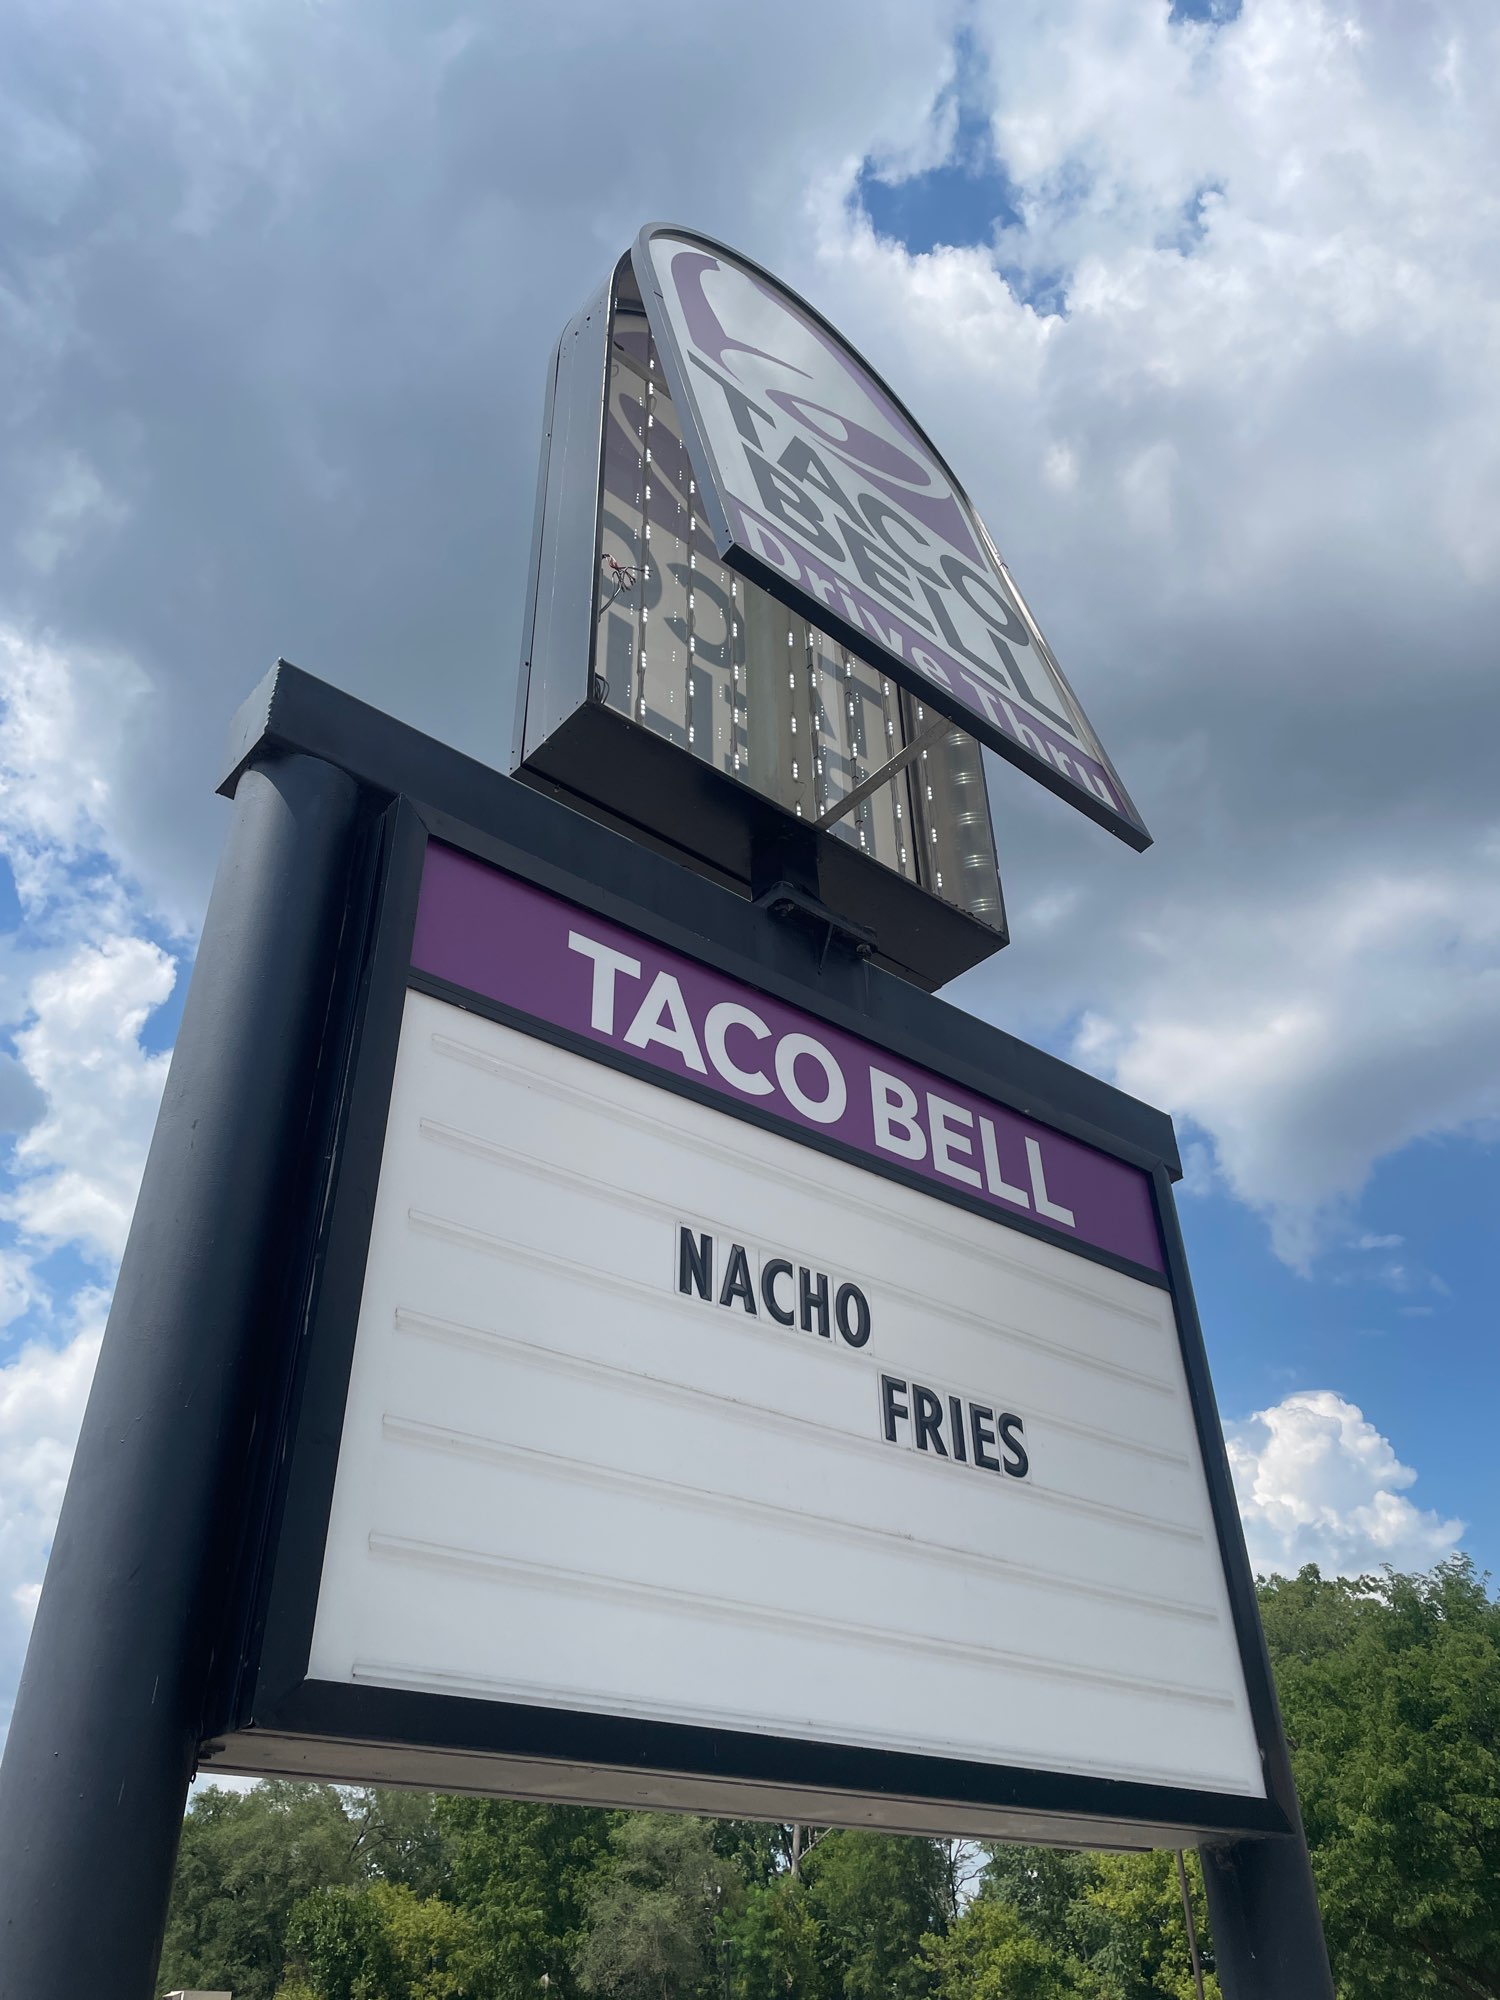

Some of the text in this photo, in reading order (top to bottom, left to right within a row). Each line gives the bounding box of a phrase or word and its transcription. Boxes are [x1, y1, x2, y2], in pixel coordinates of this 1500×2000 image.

[687, 349, 1029, 647] TACO
[741, 441, 1079, 741] BELL
[738, 509, 1119, 812] Drive Thru
[568, 931, 1076, 1228] TACO BELL
[679, 1226, 872, 1348] NACHO
[881, 1374, 1029, 1478] FRIES
